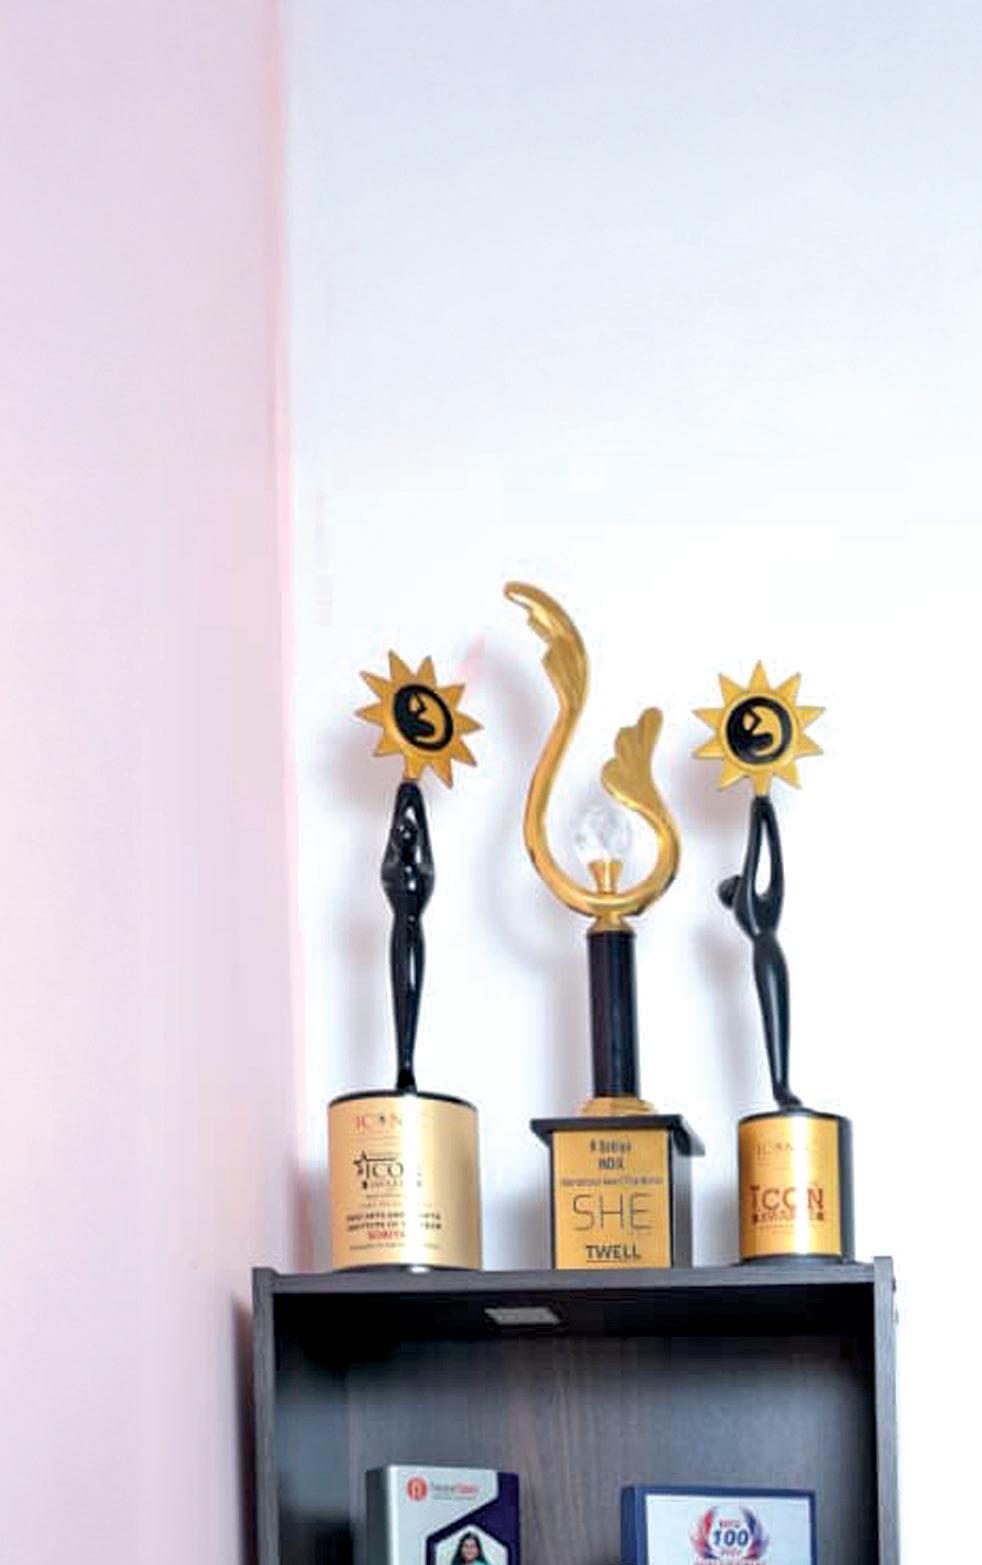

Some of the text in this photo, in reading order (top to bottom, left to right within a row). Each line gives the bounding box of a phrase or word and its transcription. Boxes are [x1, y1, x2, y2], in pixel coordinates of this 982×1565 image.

[573, 1193, 653, 1232] SHE
[585, 1244, 642, 1259] TWELL
[712, 1530, 749, 1547] 100
